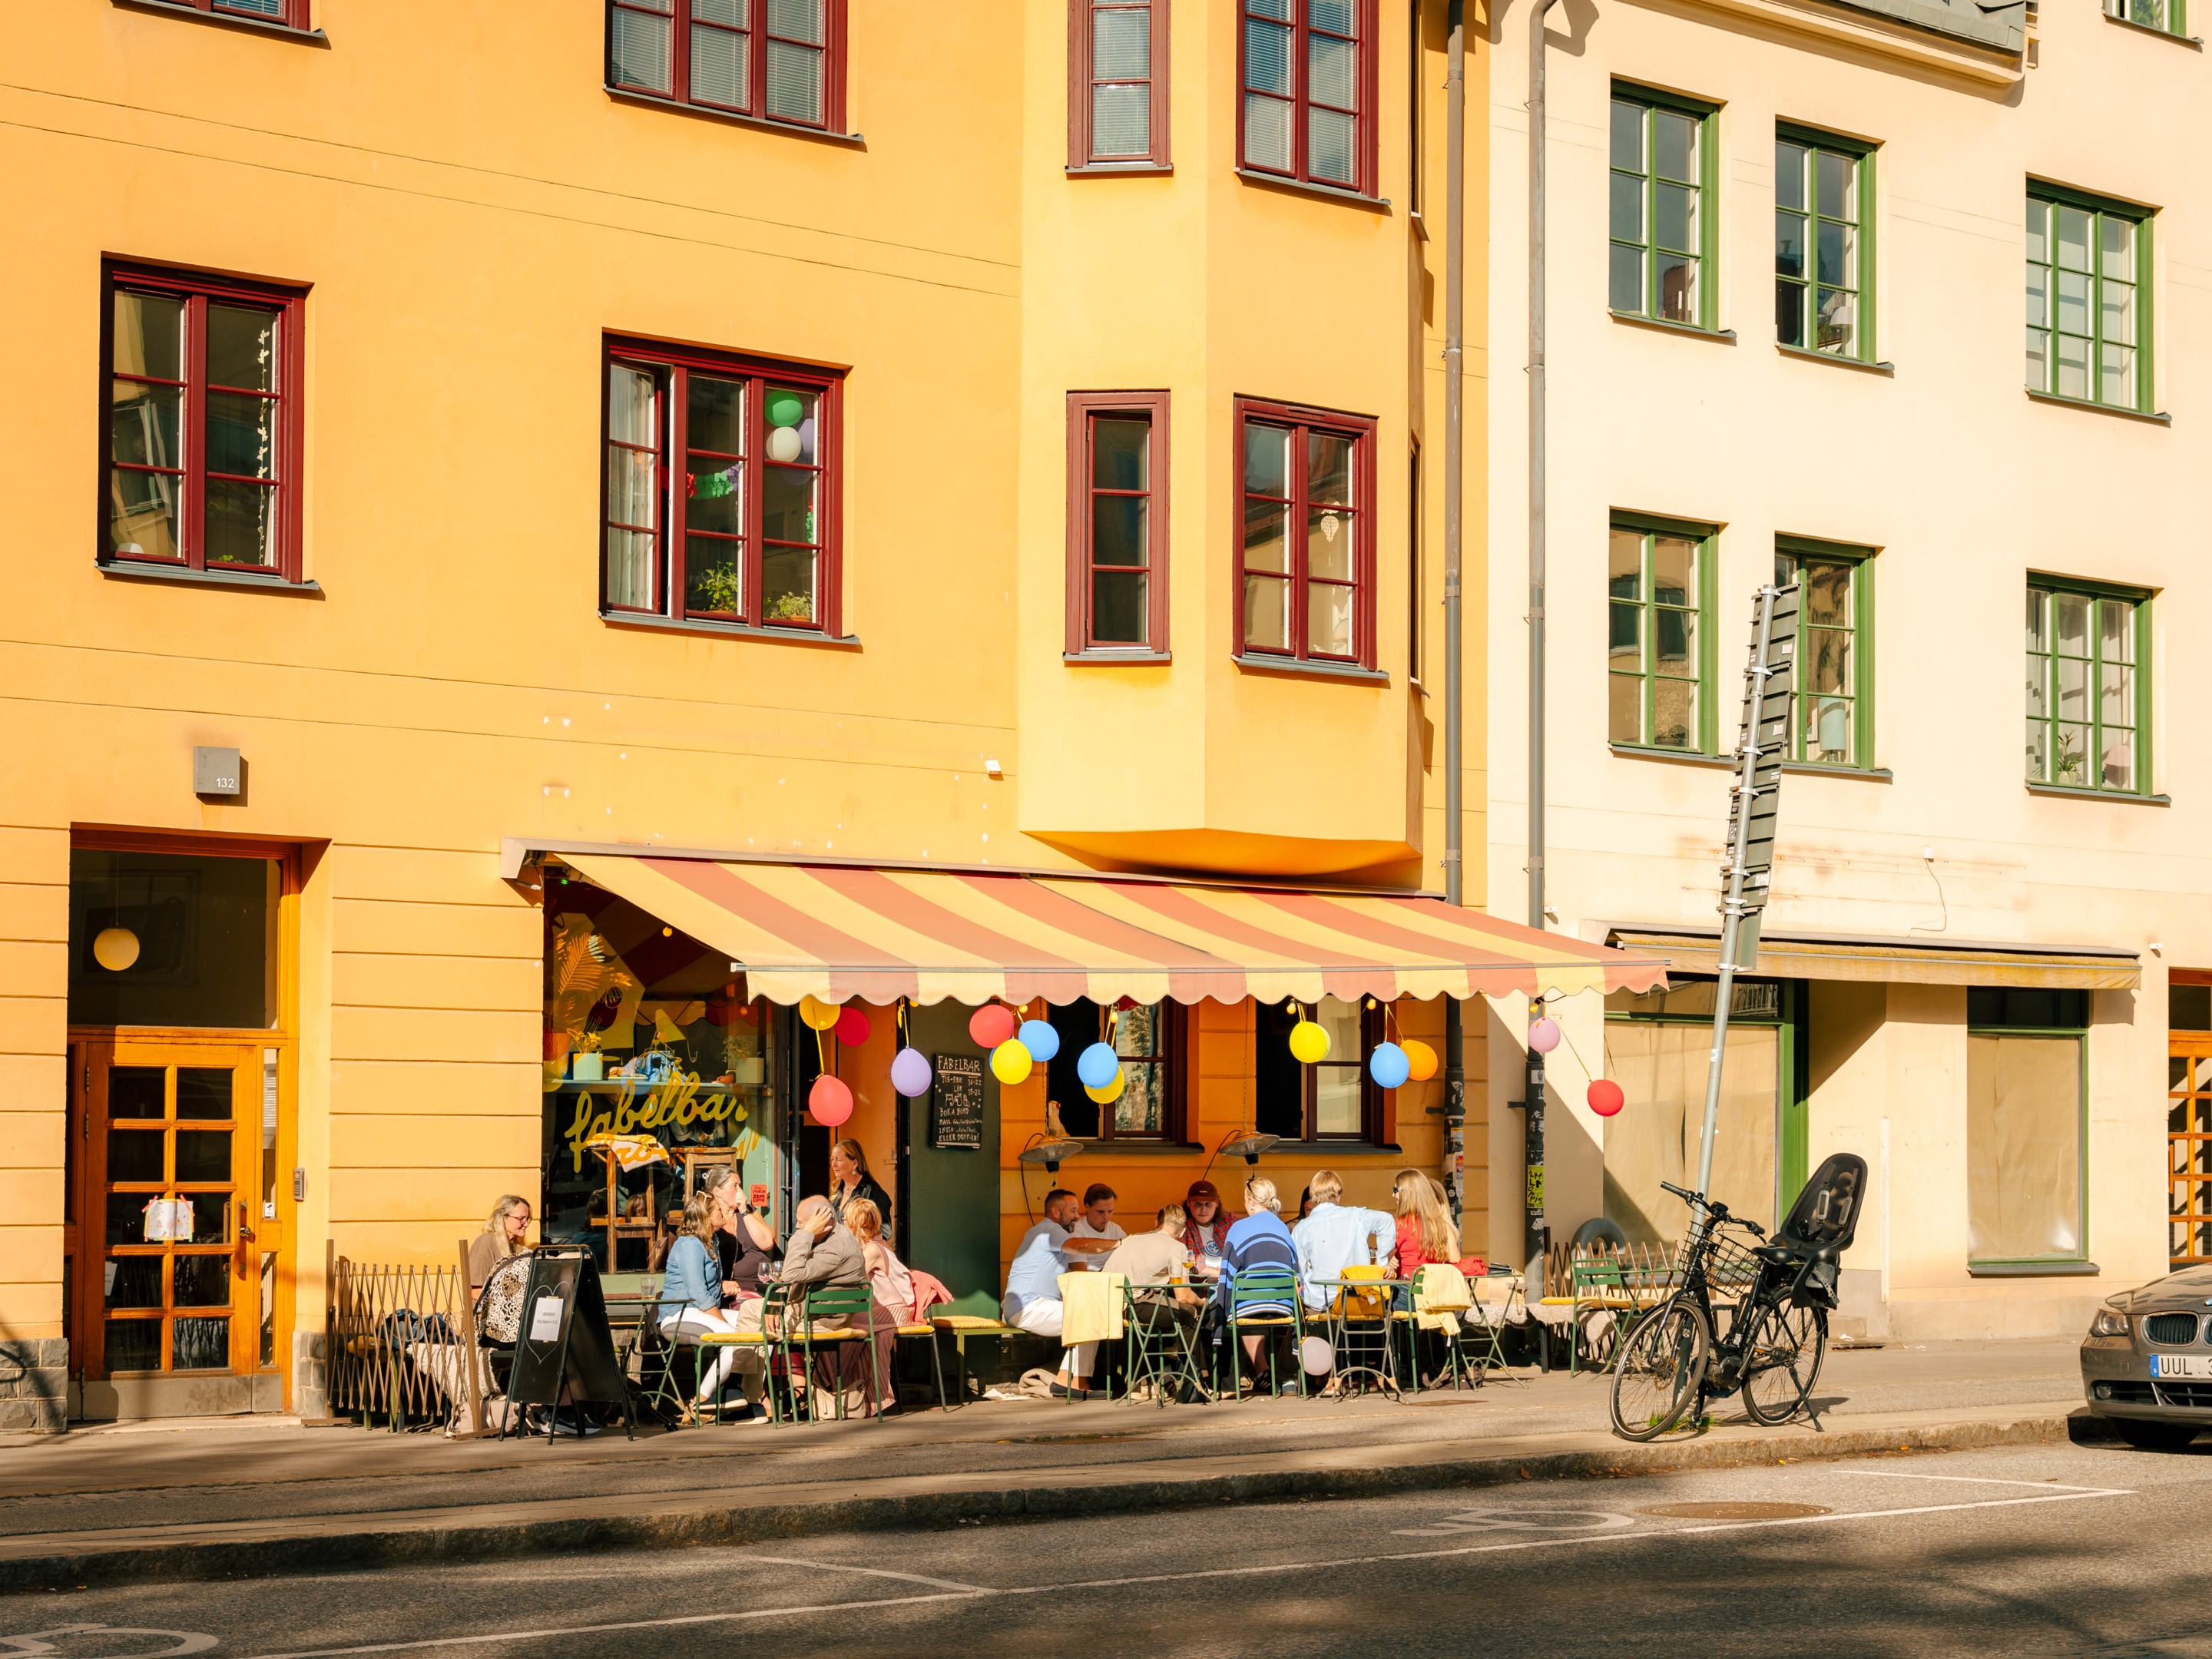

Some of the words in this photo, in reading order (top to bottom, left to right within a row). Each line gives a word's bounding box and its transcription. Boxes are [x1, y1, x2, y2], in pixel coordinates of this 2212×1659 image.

[216, 777, 234, 788] 132
[938, 1055, 980, 1072] FABELBAR
[939, 1107, 955, 1118] BOKA
[956, 1108, 969, 1116] BORD
[564, 1071, 749, 1174] fabelbar
[939, 1134, 956, 1142] ELLER
[2161, 1358, 2192, 1375] UUL
